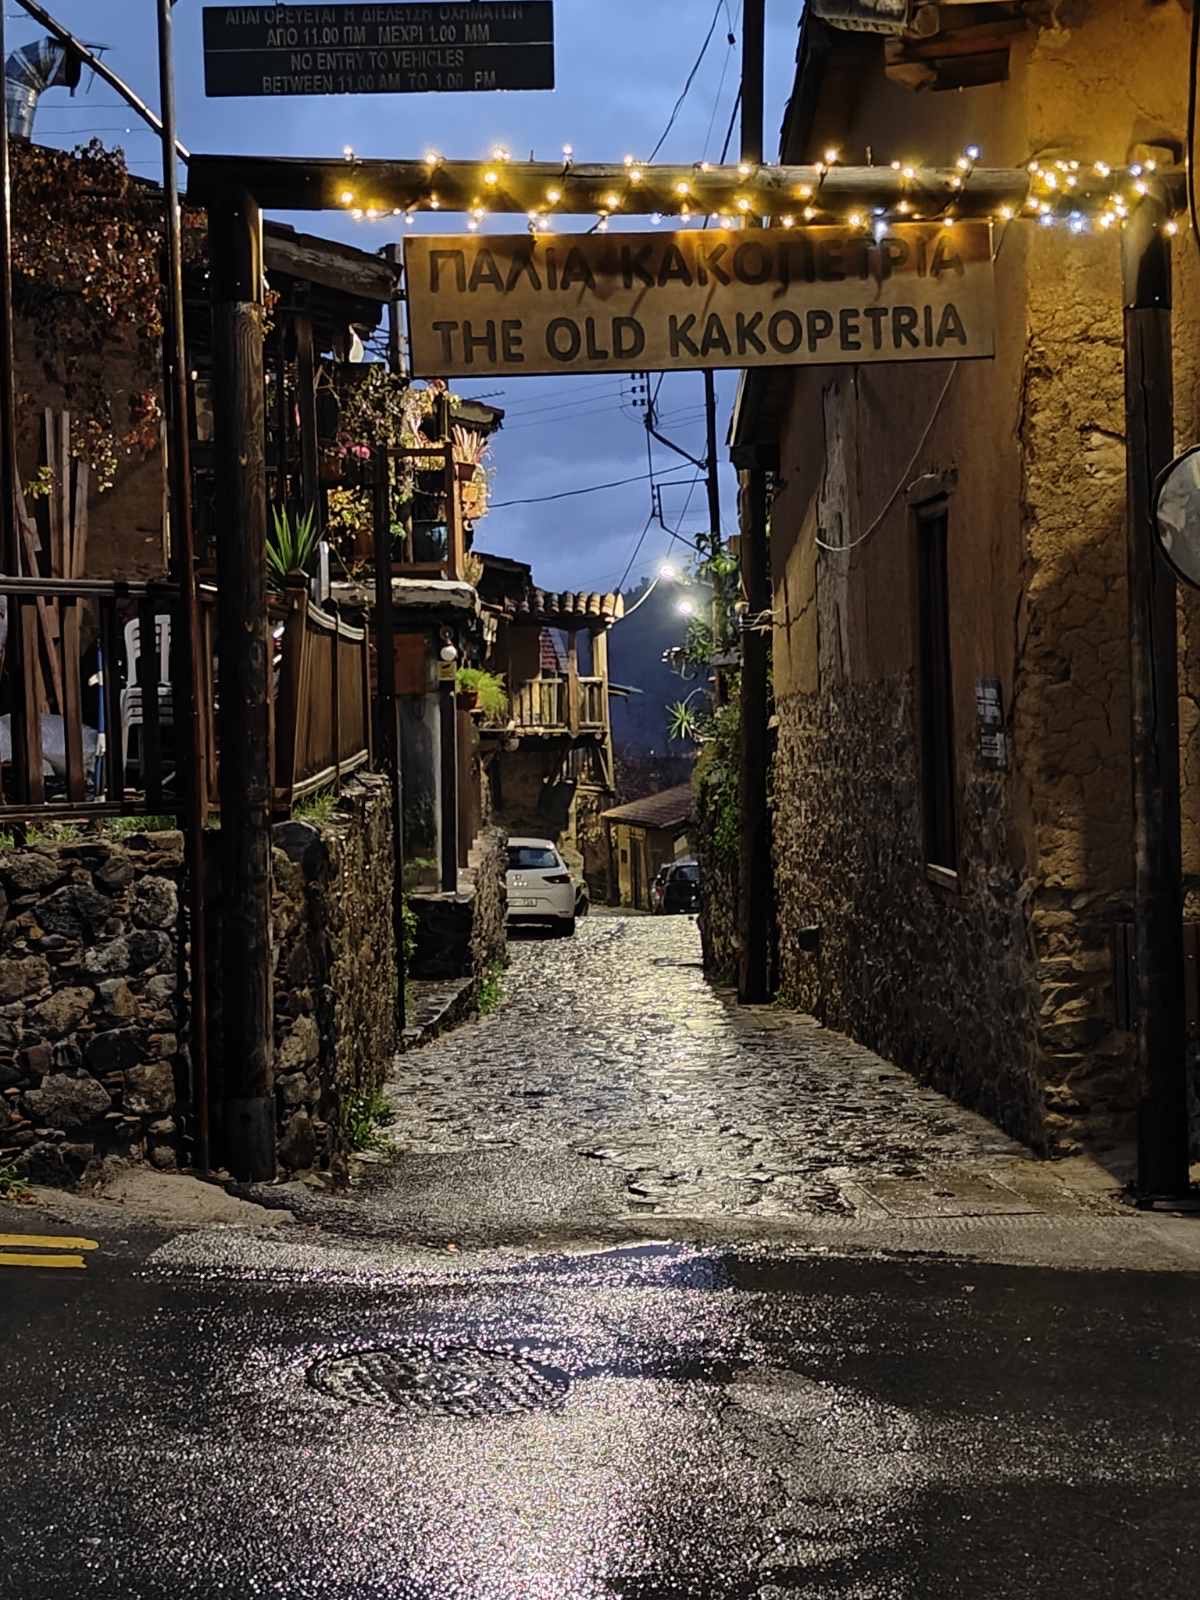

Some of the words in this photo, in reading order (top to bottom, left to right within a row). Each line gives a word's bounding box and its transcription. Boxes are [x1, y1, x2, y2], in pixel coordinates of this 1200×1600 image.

[266, 27, 298, 46] ΑΠΟ
[304, 27, 339, 45] 11.00
[343, 26, 366, 44] ΠΜ
[378, 25, 423, 44] ΜΕΧΡΙ
[464, 23, 490, 42] ΜΜ
[290, 53, 312, 71] NO
[317, 51, 366, 70] ENTRY
[368, 51, 388, 69] TO
[392, 49, 464, 69] VEHICLES
[262, 74, 333, 93] BETWEEN
[338, 74, 374, 91] 11.00
[379, 73, 400, 90] AM
[408, 73, 428, 89] TO
[474, 70, 496, 88] PM
[429, 243, 596, 293] ΠΑΛΙΑ
[620, 233, 965, 289] ΚΑΚΟΠΕΤΡΙΑ
[432, 318, 525, 364] THE
[545, 316, 646, 362] OLD
[668, 303, 967, 358] KAKOPETRIA
